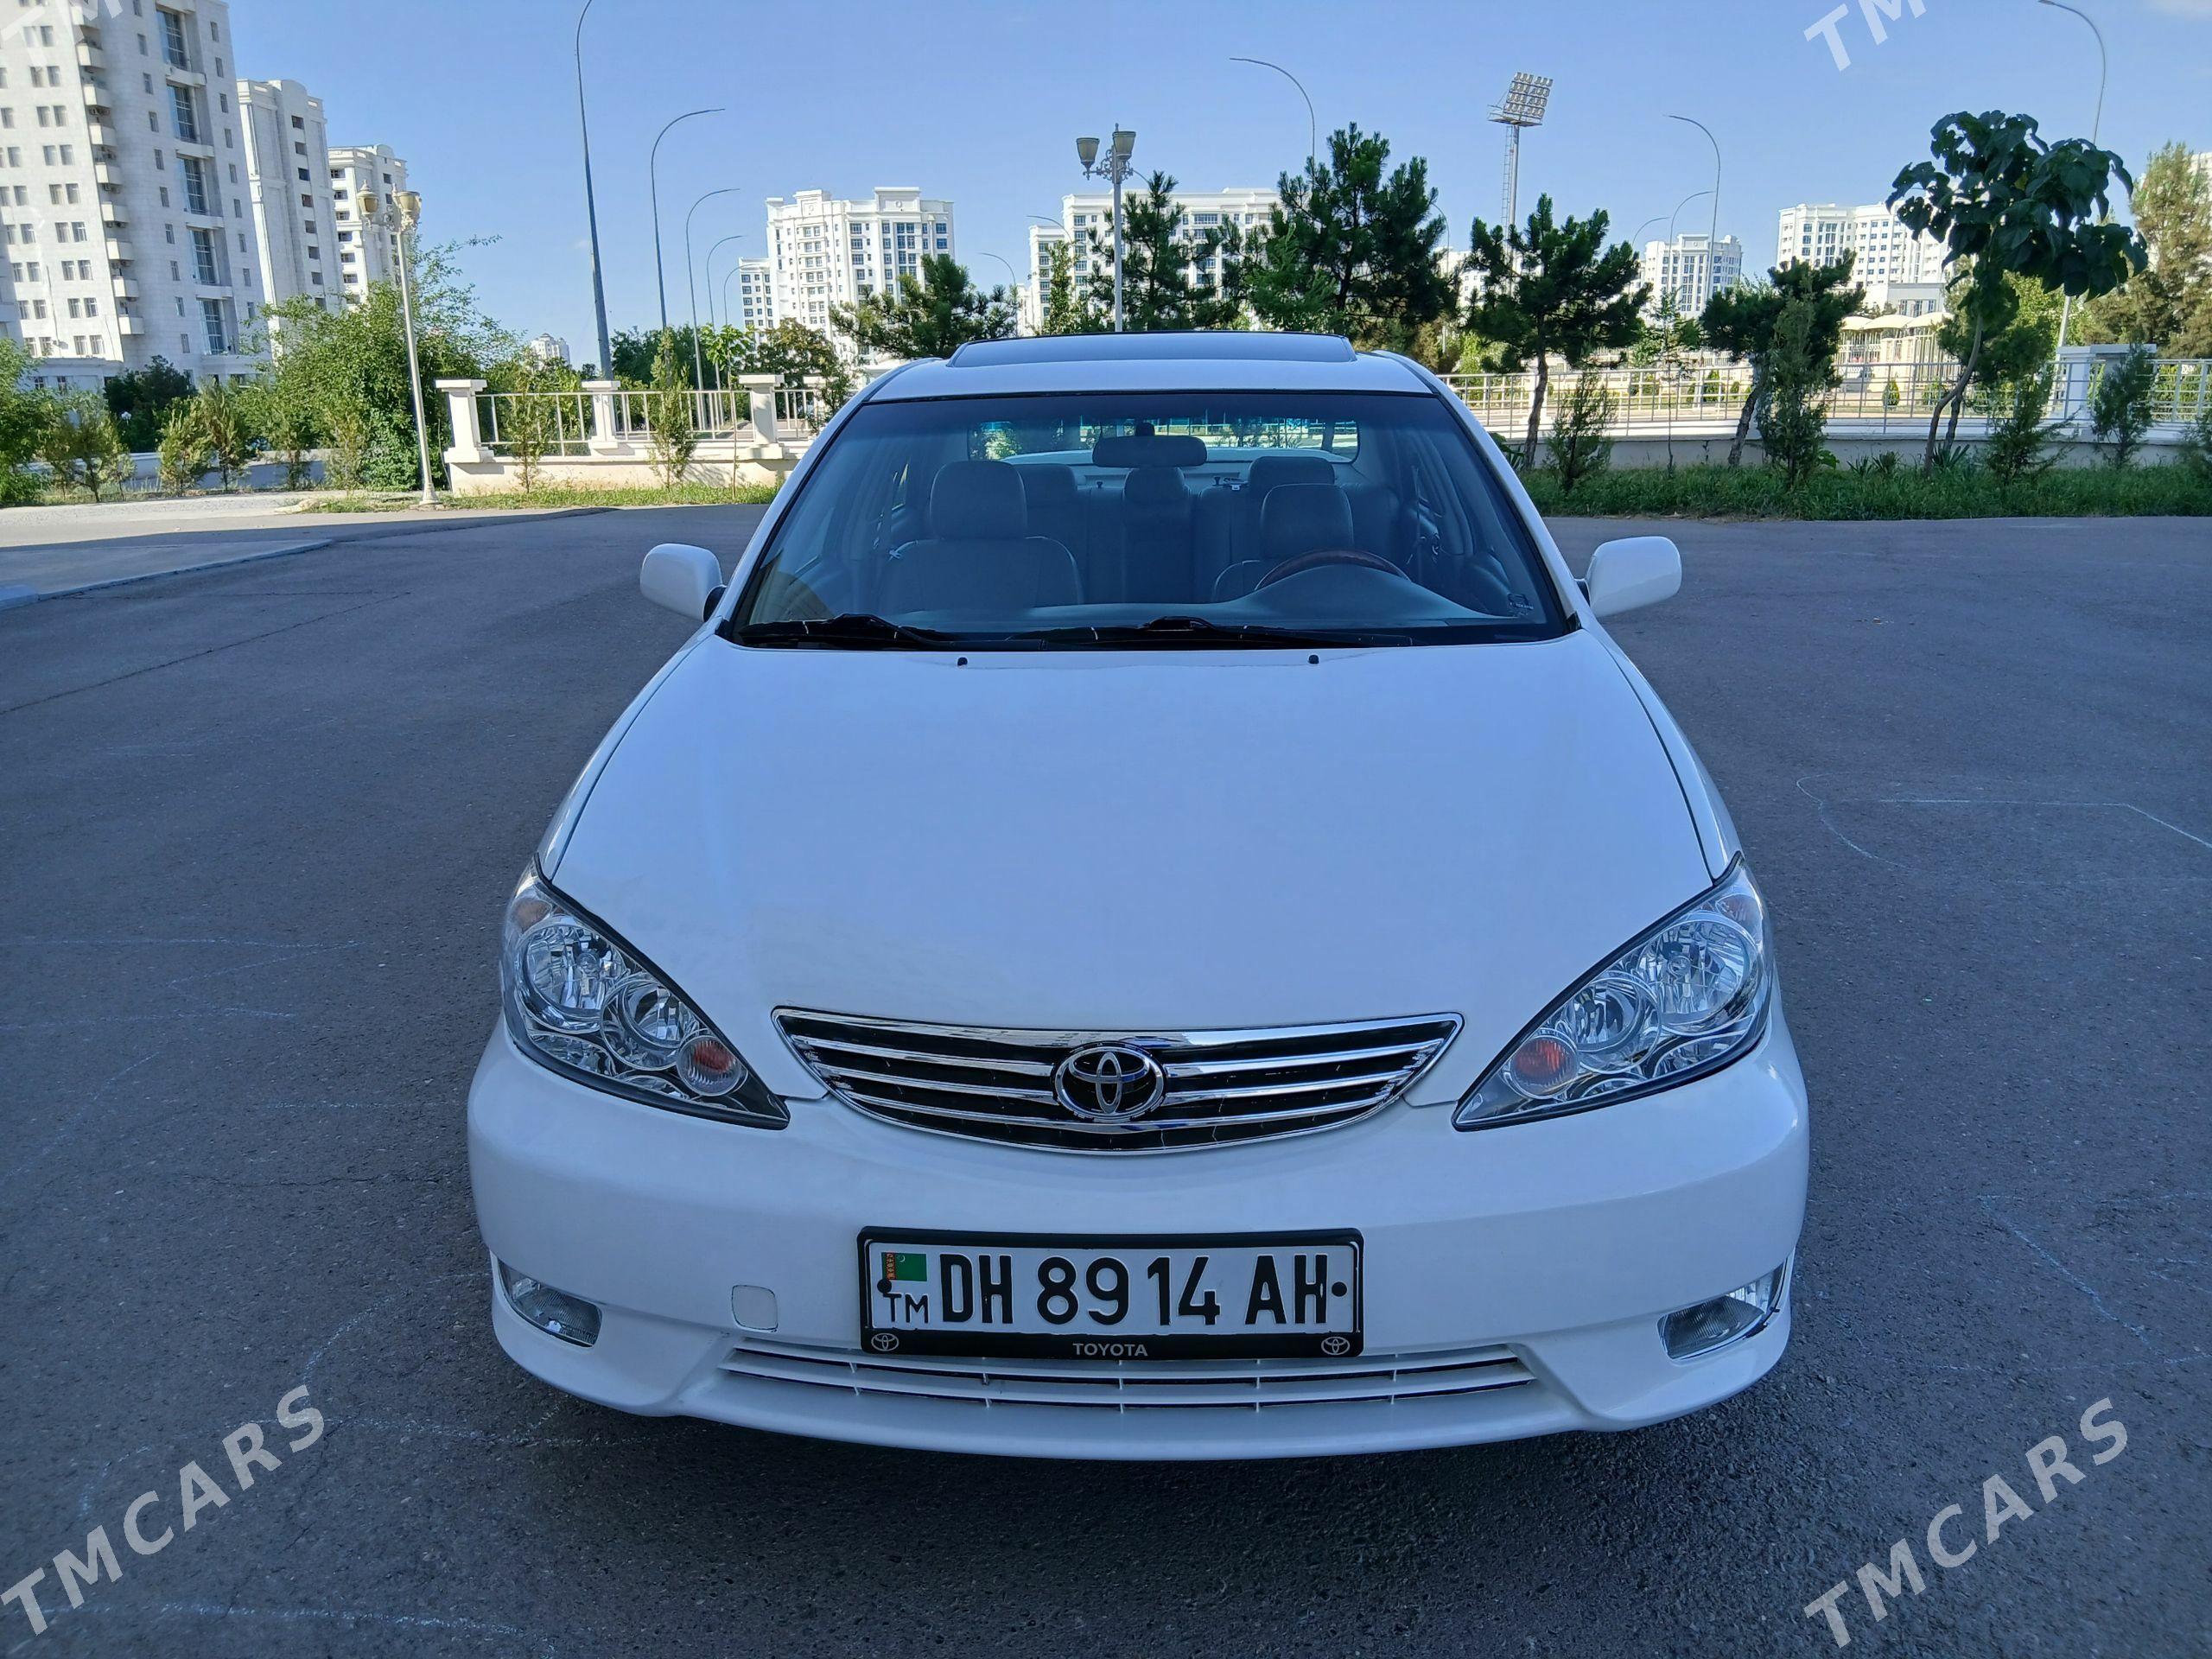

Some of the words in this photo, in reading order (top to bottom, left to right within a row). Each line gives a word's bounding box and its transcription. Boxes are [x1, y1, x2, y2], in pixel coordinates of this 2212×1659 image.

[939, 1253, 1014, 1324] DH
[1037, 1255, 1221, 1325] 8914
[1244, 1255, 1328, 1325] AH
[882, 1294, 929, 1324] TM
[1072, 1342, 1148, 1357] TOYOTA
